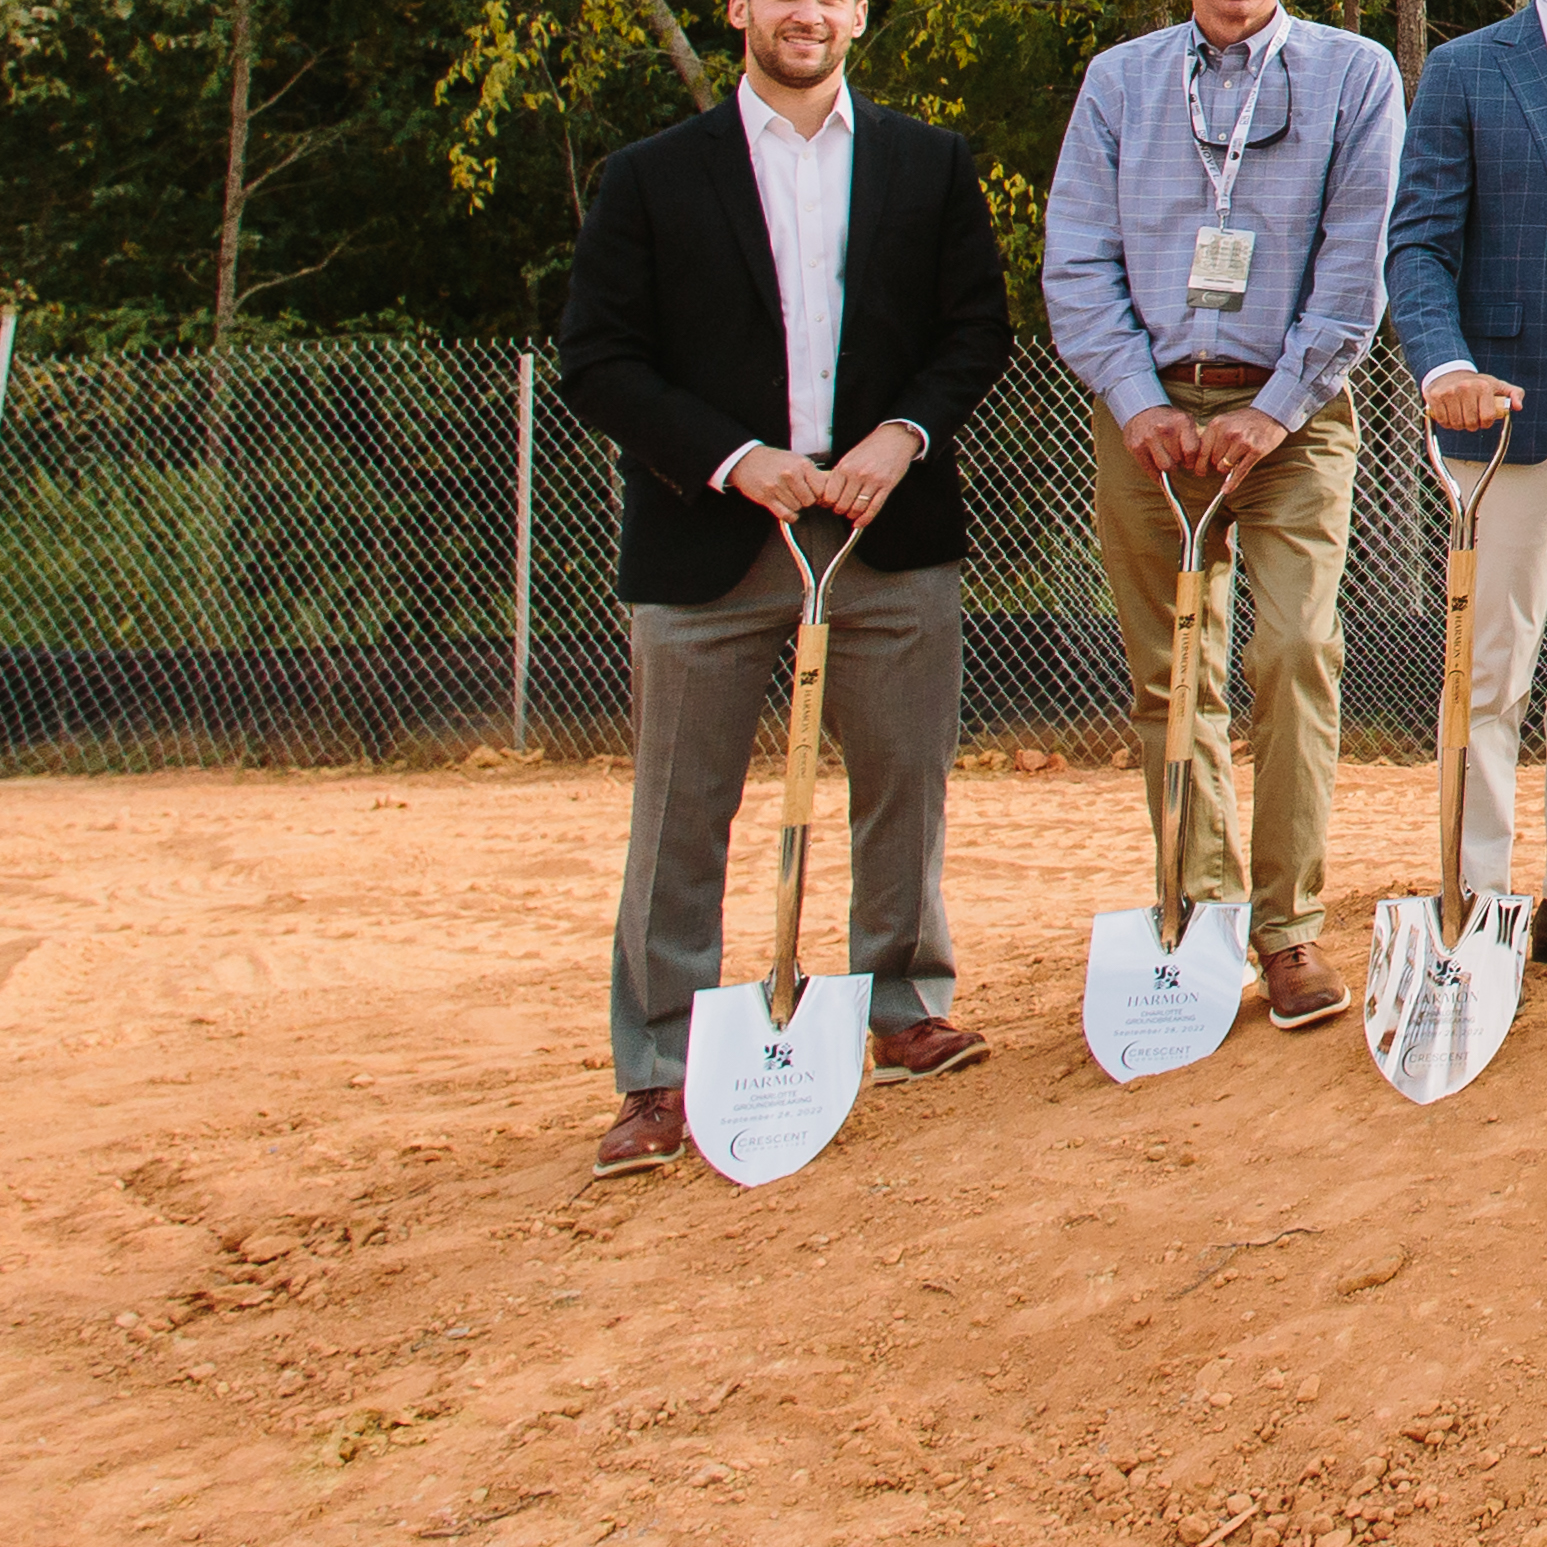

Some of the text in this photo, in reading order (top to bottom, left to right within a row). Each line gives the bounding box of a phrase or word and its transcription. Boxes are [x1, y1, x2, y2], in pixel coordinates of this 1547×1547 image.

[1127, 992, 1199, 1007] HARMON
[1128, 1045, 1191, 1057] CRESCENT
[1410, 1052, 1468, 1063] CRESCENT
[735, 1071, 815, 1091] HARMON
[738, 1131, 808, 1147] CRESCENT
